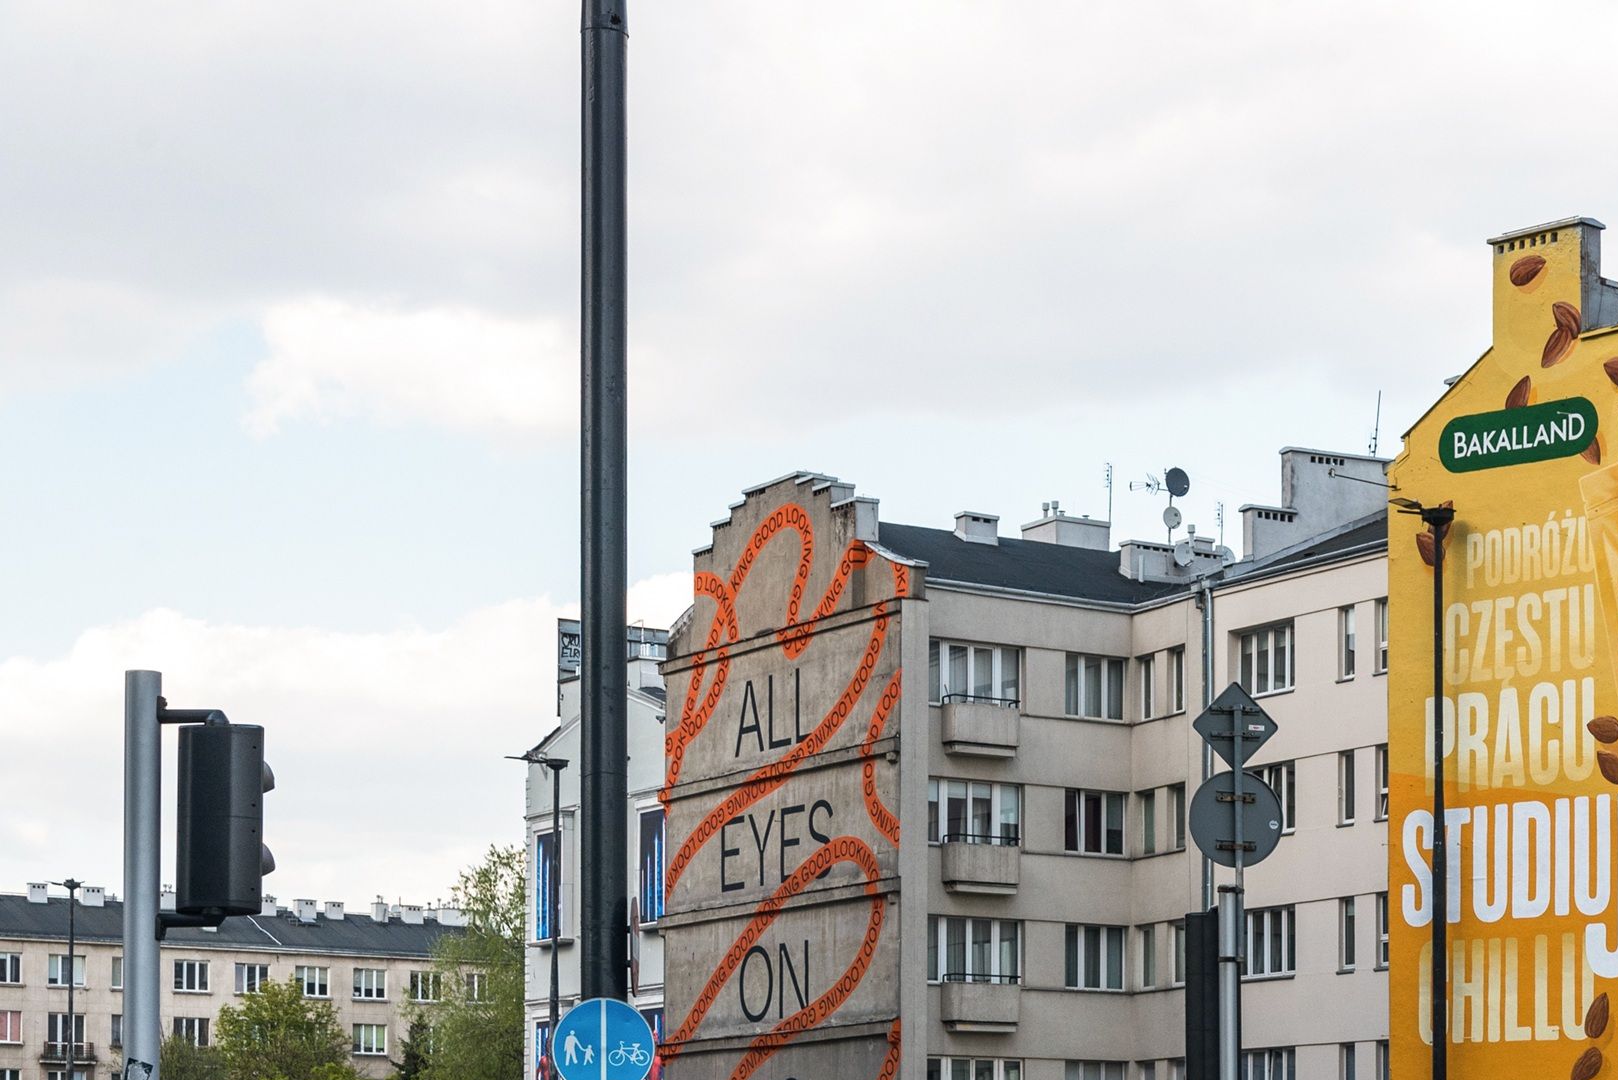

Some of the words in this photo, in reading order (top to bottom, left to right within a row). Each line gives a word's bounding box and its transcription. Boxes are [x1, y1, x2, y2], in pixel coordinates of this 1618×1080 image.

[1453, 413, 1585, 459] BAKALLAND
[754, 511, 784, 550] GOOD
[785, 508, 814, 580] LOOKING
[1445, 584, 1595, 688] CZĘSTU
[735, 668, 813, 757] ALL
[807, 691, 856, 757] LOOKING
[1425, 677, 1595, 796] PRACU
[697, 810, 726, 843] GOOD
[721, 799, 834, 893] EYES
[801, 847, 832, 884] GOOD
[833, 840, 880, 884] LOOKING
[727, 926, 756, 969] GOOD
[687, 966, 728, 1035] LOOKING
[740, 940, 810, 1023] ON
[819, 959, 867, 1013] LOOKING
